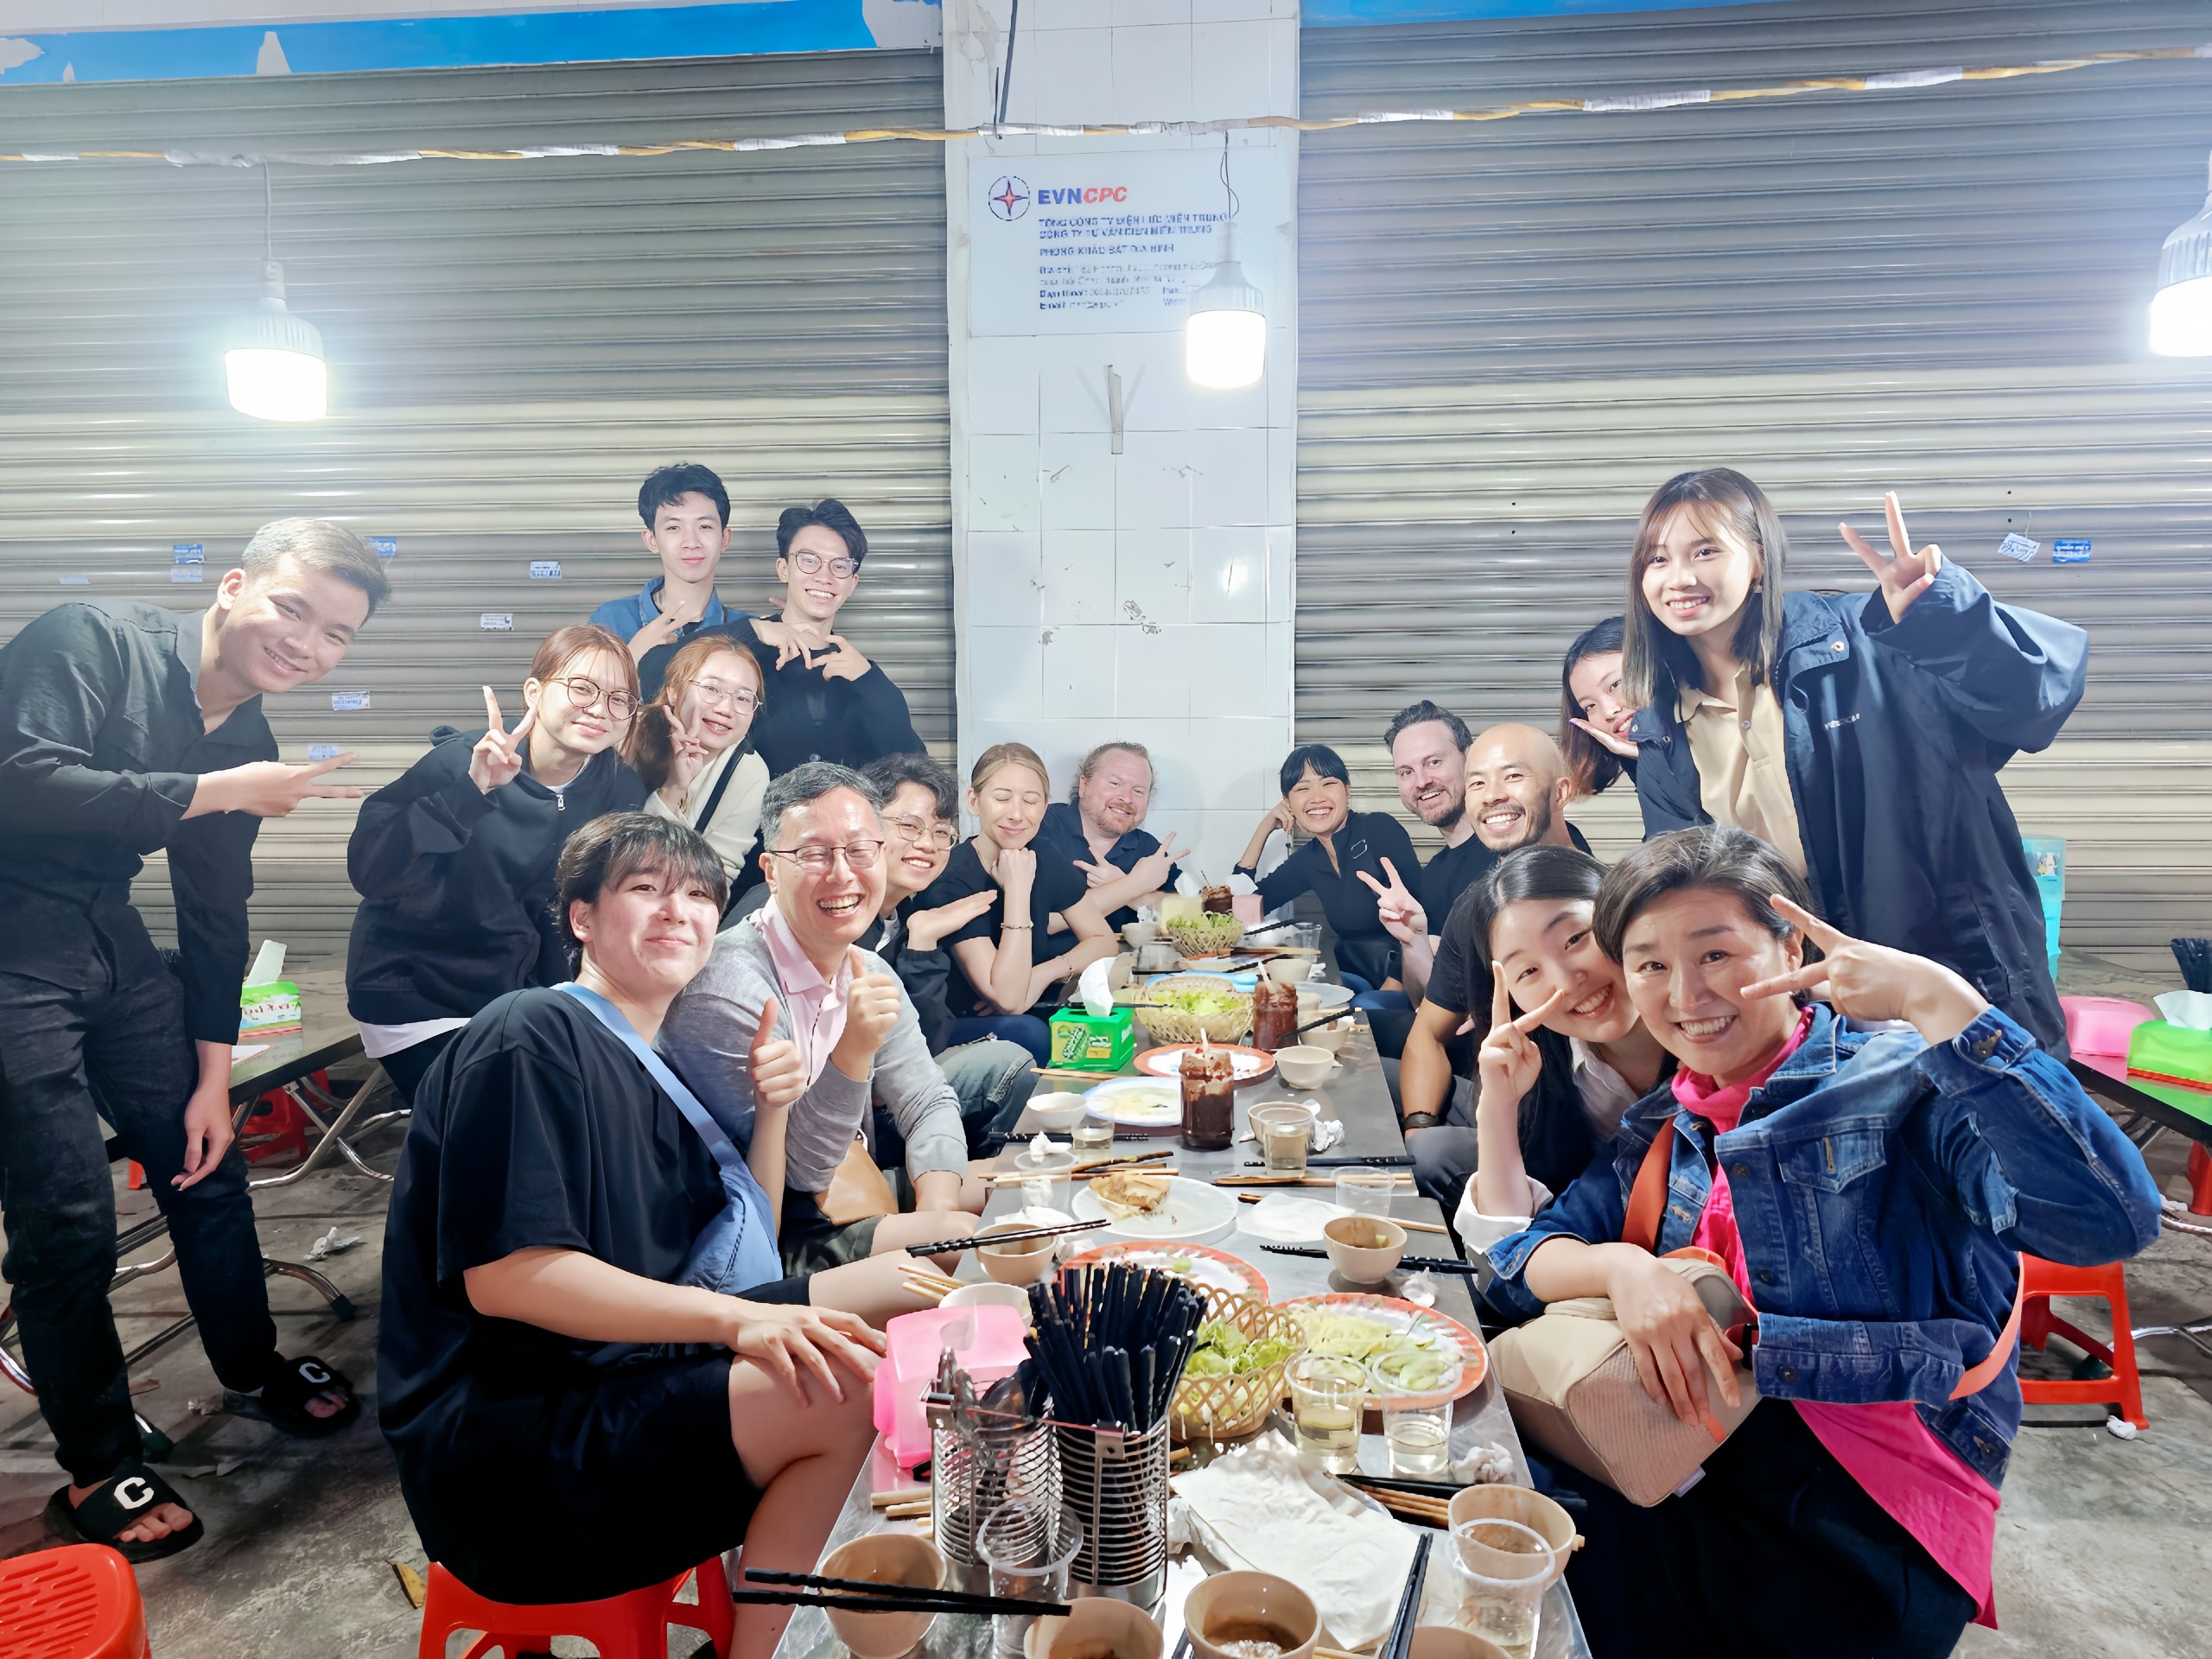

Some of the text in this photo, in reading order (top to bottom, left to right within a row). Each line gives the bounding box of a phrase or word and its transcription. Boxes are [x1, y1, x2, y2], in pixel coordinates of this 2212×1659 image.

[1038, 187, 1128, 204] EVNCPC
[299, 1362, 331, 1383] C
[113, 1477, 155, 1510] C
